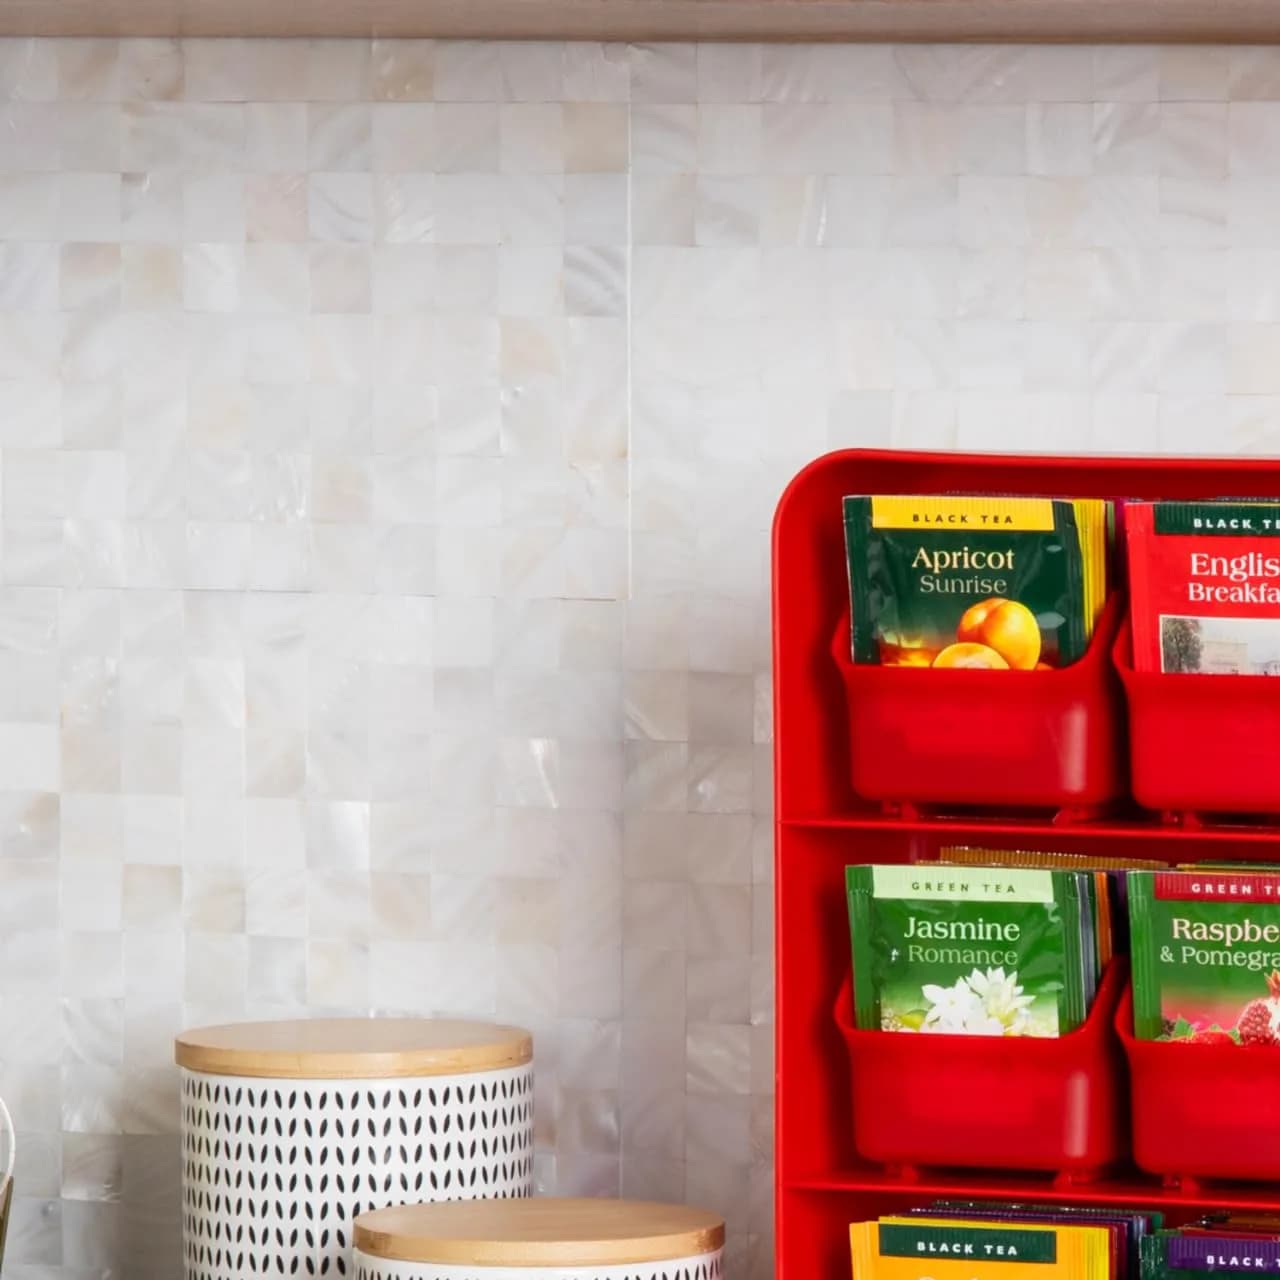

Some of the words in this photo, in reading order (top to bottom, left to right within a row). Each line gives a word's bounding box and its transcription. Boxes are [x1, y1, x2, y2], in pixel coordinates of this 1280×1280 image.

[912, 513, 968, 523] BLACK
[981, 515, 1013, 524] TEA
[1193, 518, 1252, 529] BLACK
[911, 547, 1015, 574] Apricot
[919, 575, 1007, 594] Sunrise
[911, 882, 969, 892] GREEN
[982, 884, 1015, 893] TEA
[1191, 883, 1252, 895] GREEN
[904, 917, 1020, 942] Jasmine
[908, 945, 1018, 966] Romance
[1160, 945, 1174, 964] &
[917, 1241, 973, 1255] BLACK
[984, 1245, 1018, 1256] TEA
[1207, 1255, 1264, 1268] BLACK
